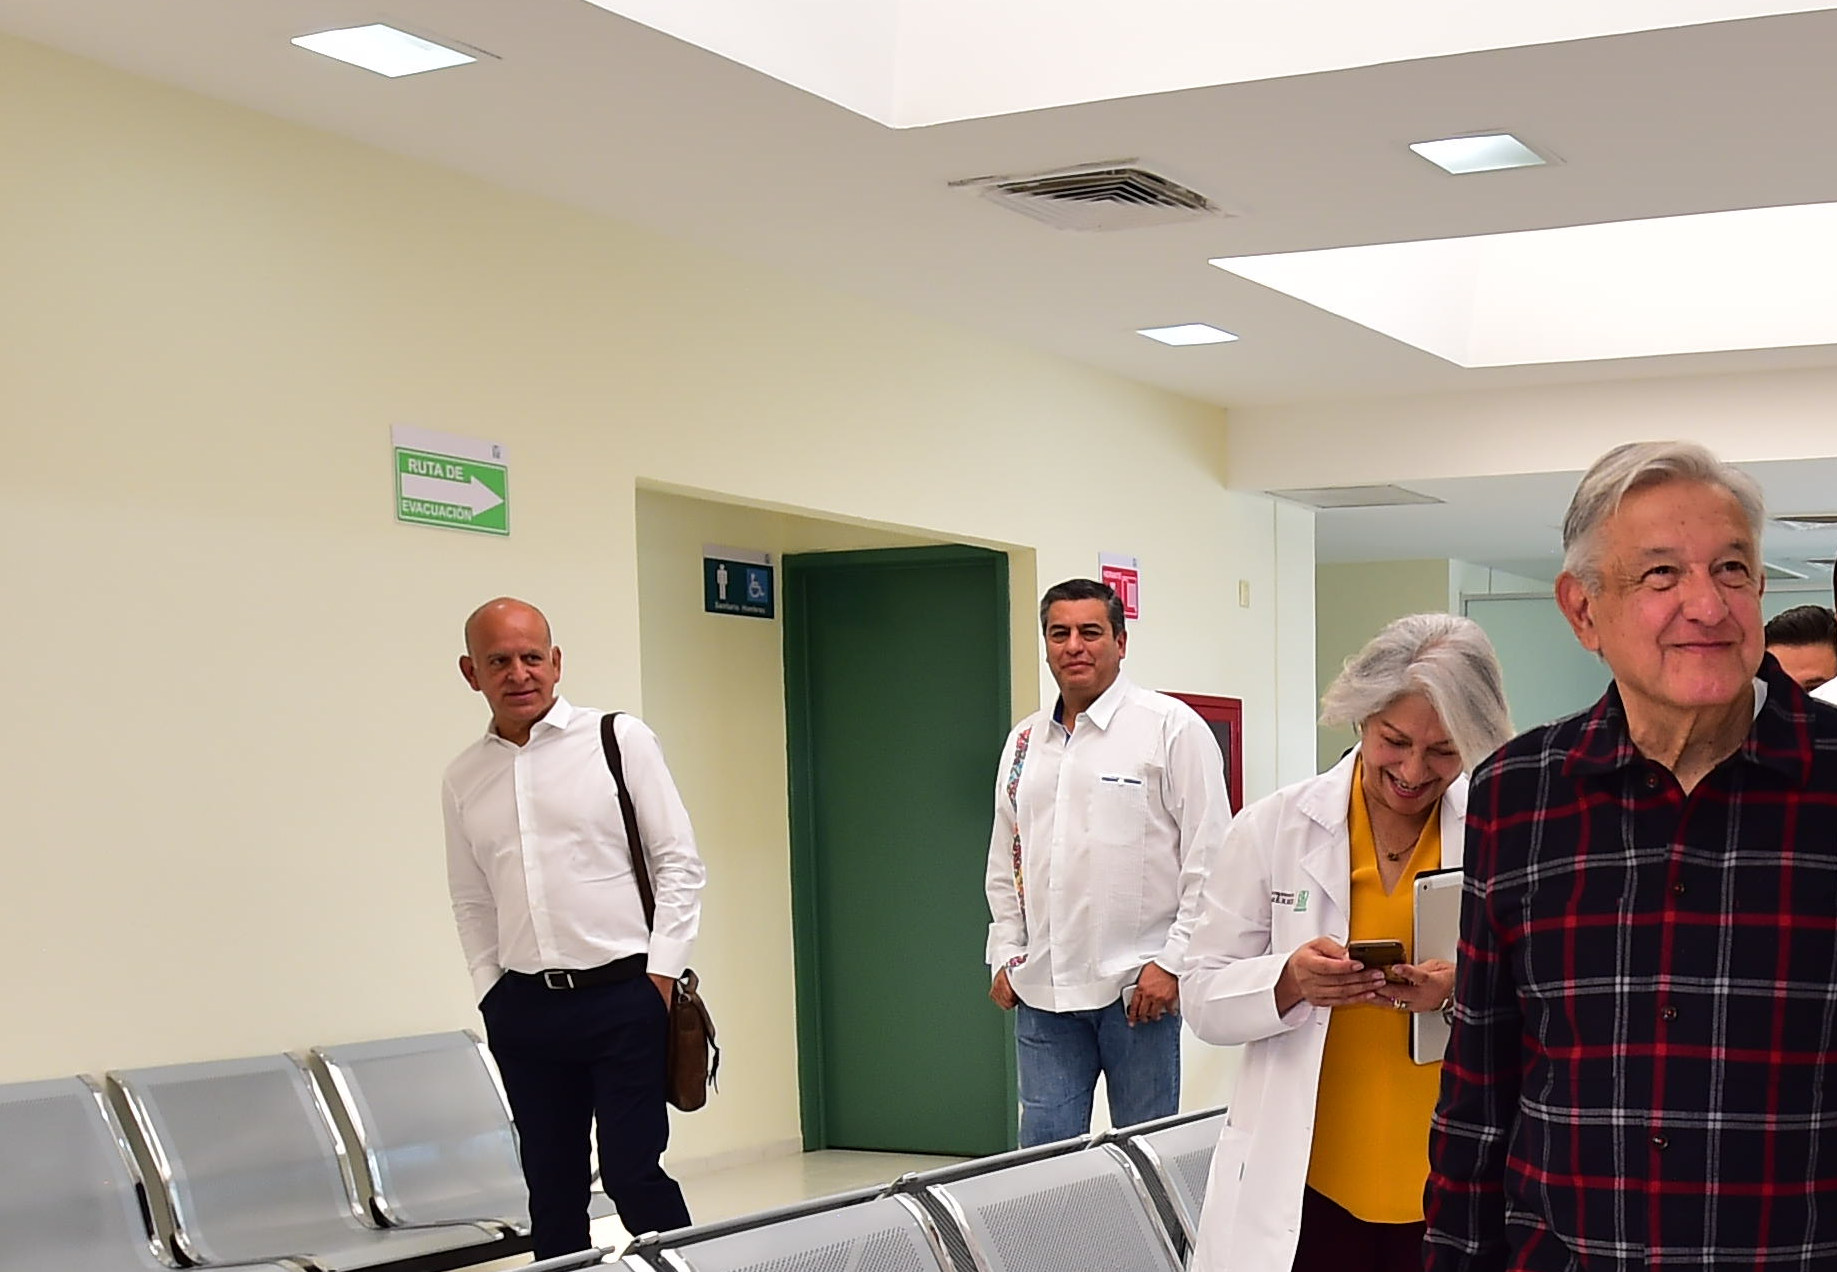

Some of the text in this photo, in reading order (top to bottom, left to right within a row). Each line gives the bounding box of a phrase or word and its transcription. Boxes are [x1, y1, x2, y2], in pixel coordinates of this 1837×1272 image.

[408, 458, 464, 480] RUTA DE
[402, 499, 472, 521] EVACUACIÓN
